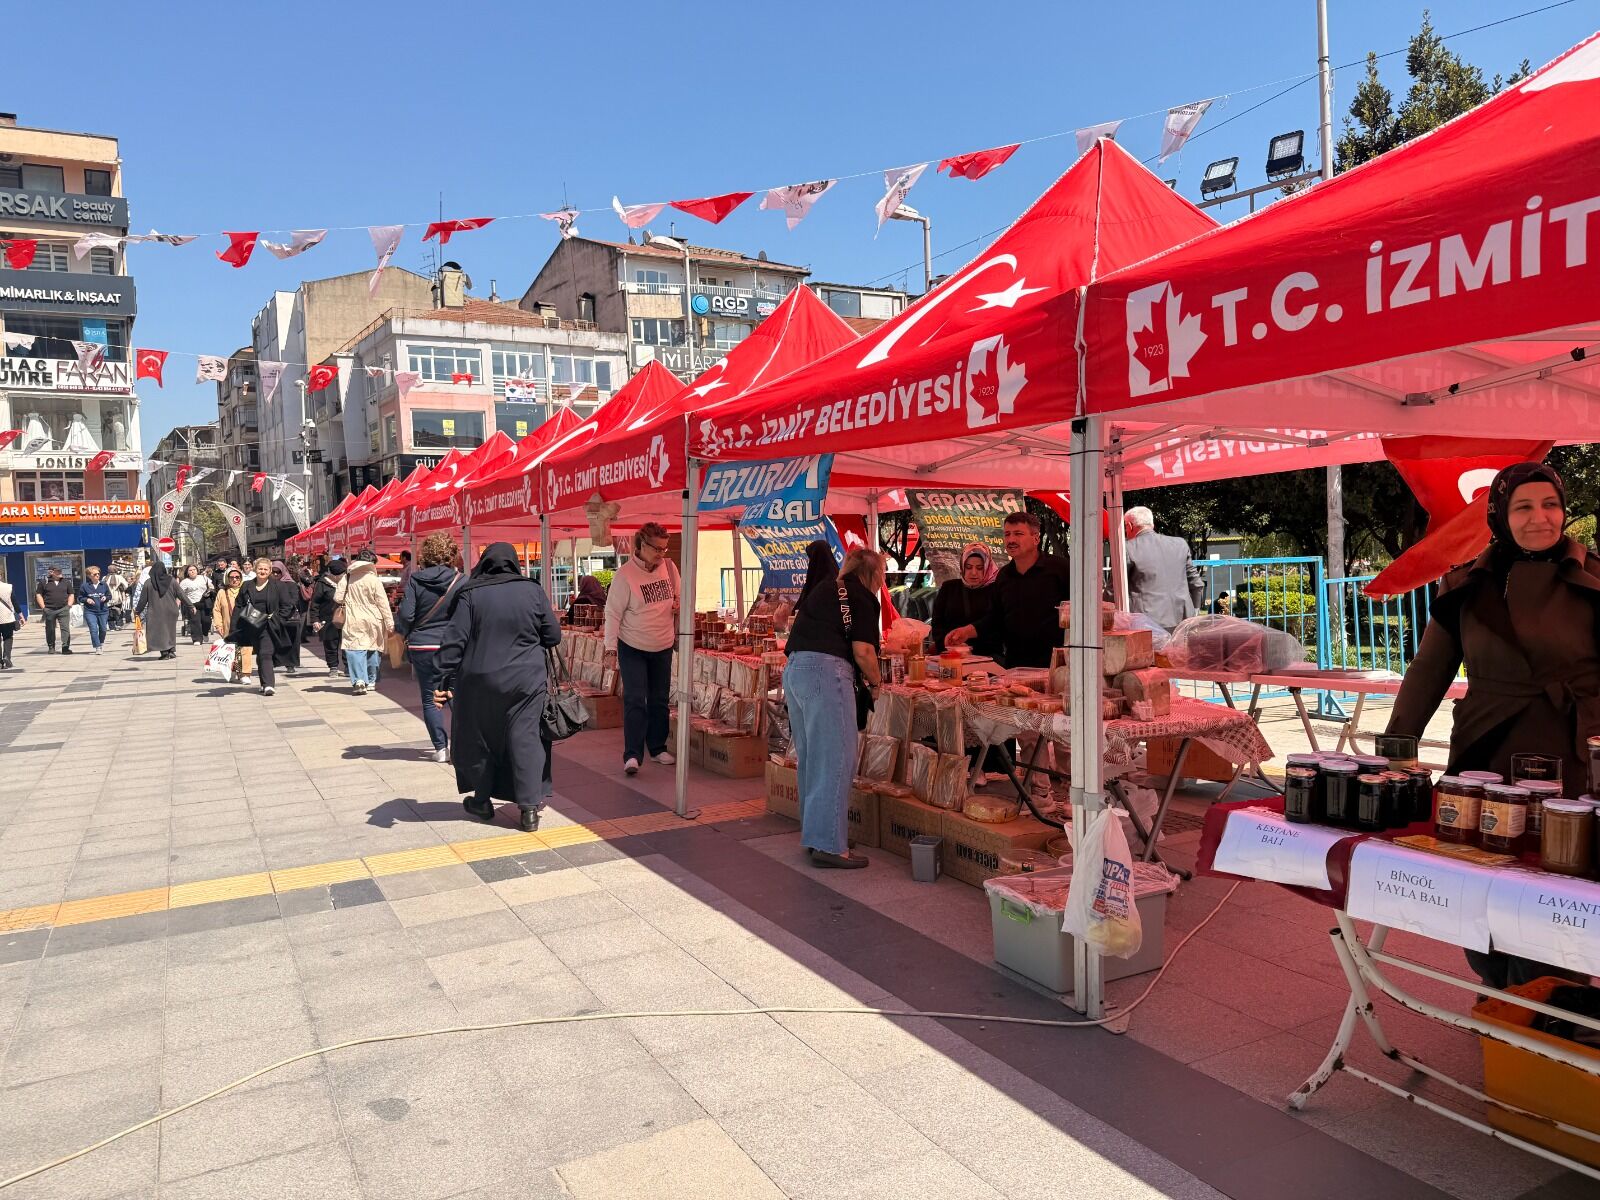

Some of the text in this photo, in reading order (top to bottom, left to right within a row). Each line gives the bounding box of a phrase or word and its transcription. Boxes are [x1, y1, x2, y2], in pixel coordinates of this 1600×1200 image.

[73, 199, 115, 213] beauty
[73, 210, 113, 222] center
[1211, 195, 1600, 347] T.C. İZMİT
[0, 285, 121, 305] MİMARLIK & İNŞAAT
[712, 295, 748, 310] AGD
[661, 347, 726, 369] İYİ PART
[1143, 344, 1164, 358] 1923
[0, 357, 47, 372] HAC
[0, 370, 53, 387] UMRE
[979, 386, 995, 397] 1923
[755, 404, 815, 446] İZMİT
[815, 360, 963, 435] BELEDİYESİ
[558, 447, 650, 497] T.C. İZMİT BELEDİYESİ
[699, 454, 822, 505] ERZURUM
[1, 506, 30, 517] ARA
[33, 504, 77, 518] İŞİTME
[79, 504, 146, 516] CİHAZLARI
[767, 498, 825, 525] BALI
[915, 493, 1022, 514] SAPANCA
[925, 514, 958, 526] DOĞAL
[959, 516, 1002, 528] KESTANE
[949, 532, 980, 542] LEYLEK
[1256, 823, 1301, 838] KESTANE
[1261, 834, 1284, 846] BALI
[1390, 870, 1435, 890] BİNGÖL
[1377, 880, 1449, 908] YAYLA BALI
[1537, 893, 1600, 915] LAVANT
[1552, 912, 1588, 929] BALI
